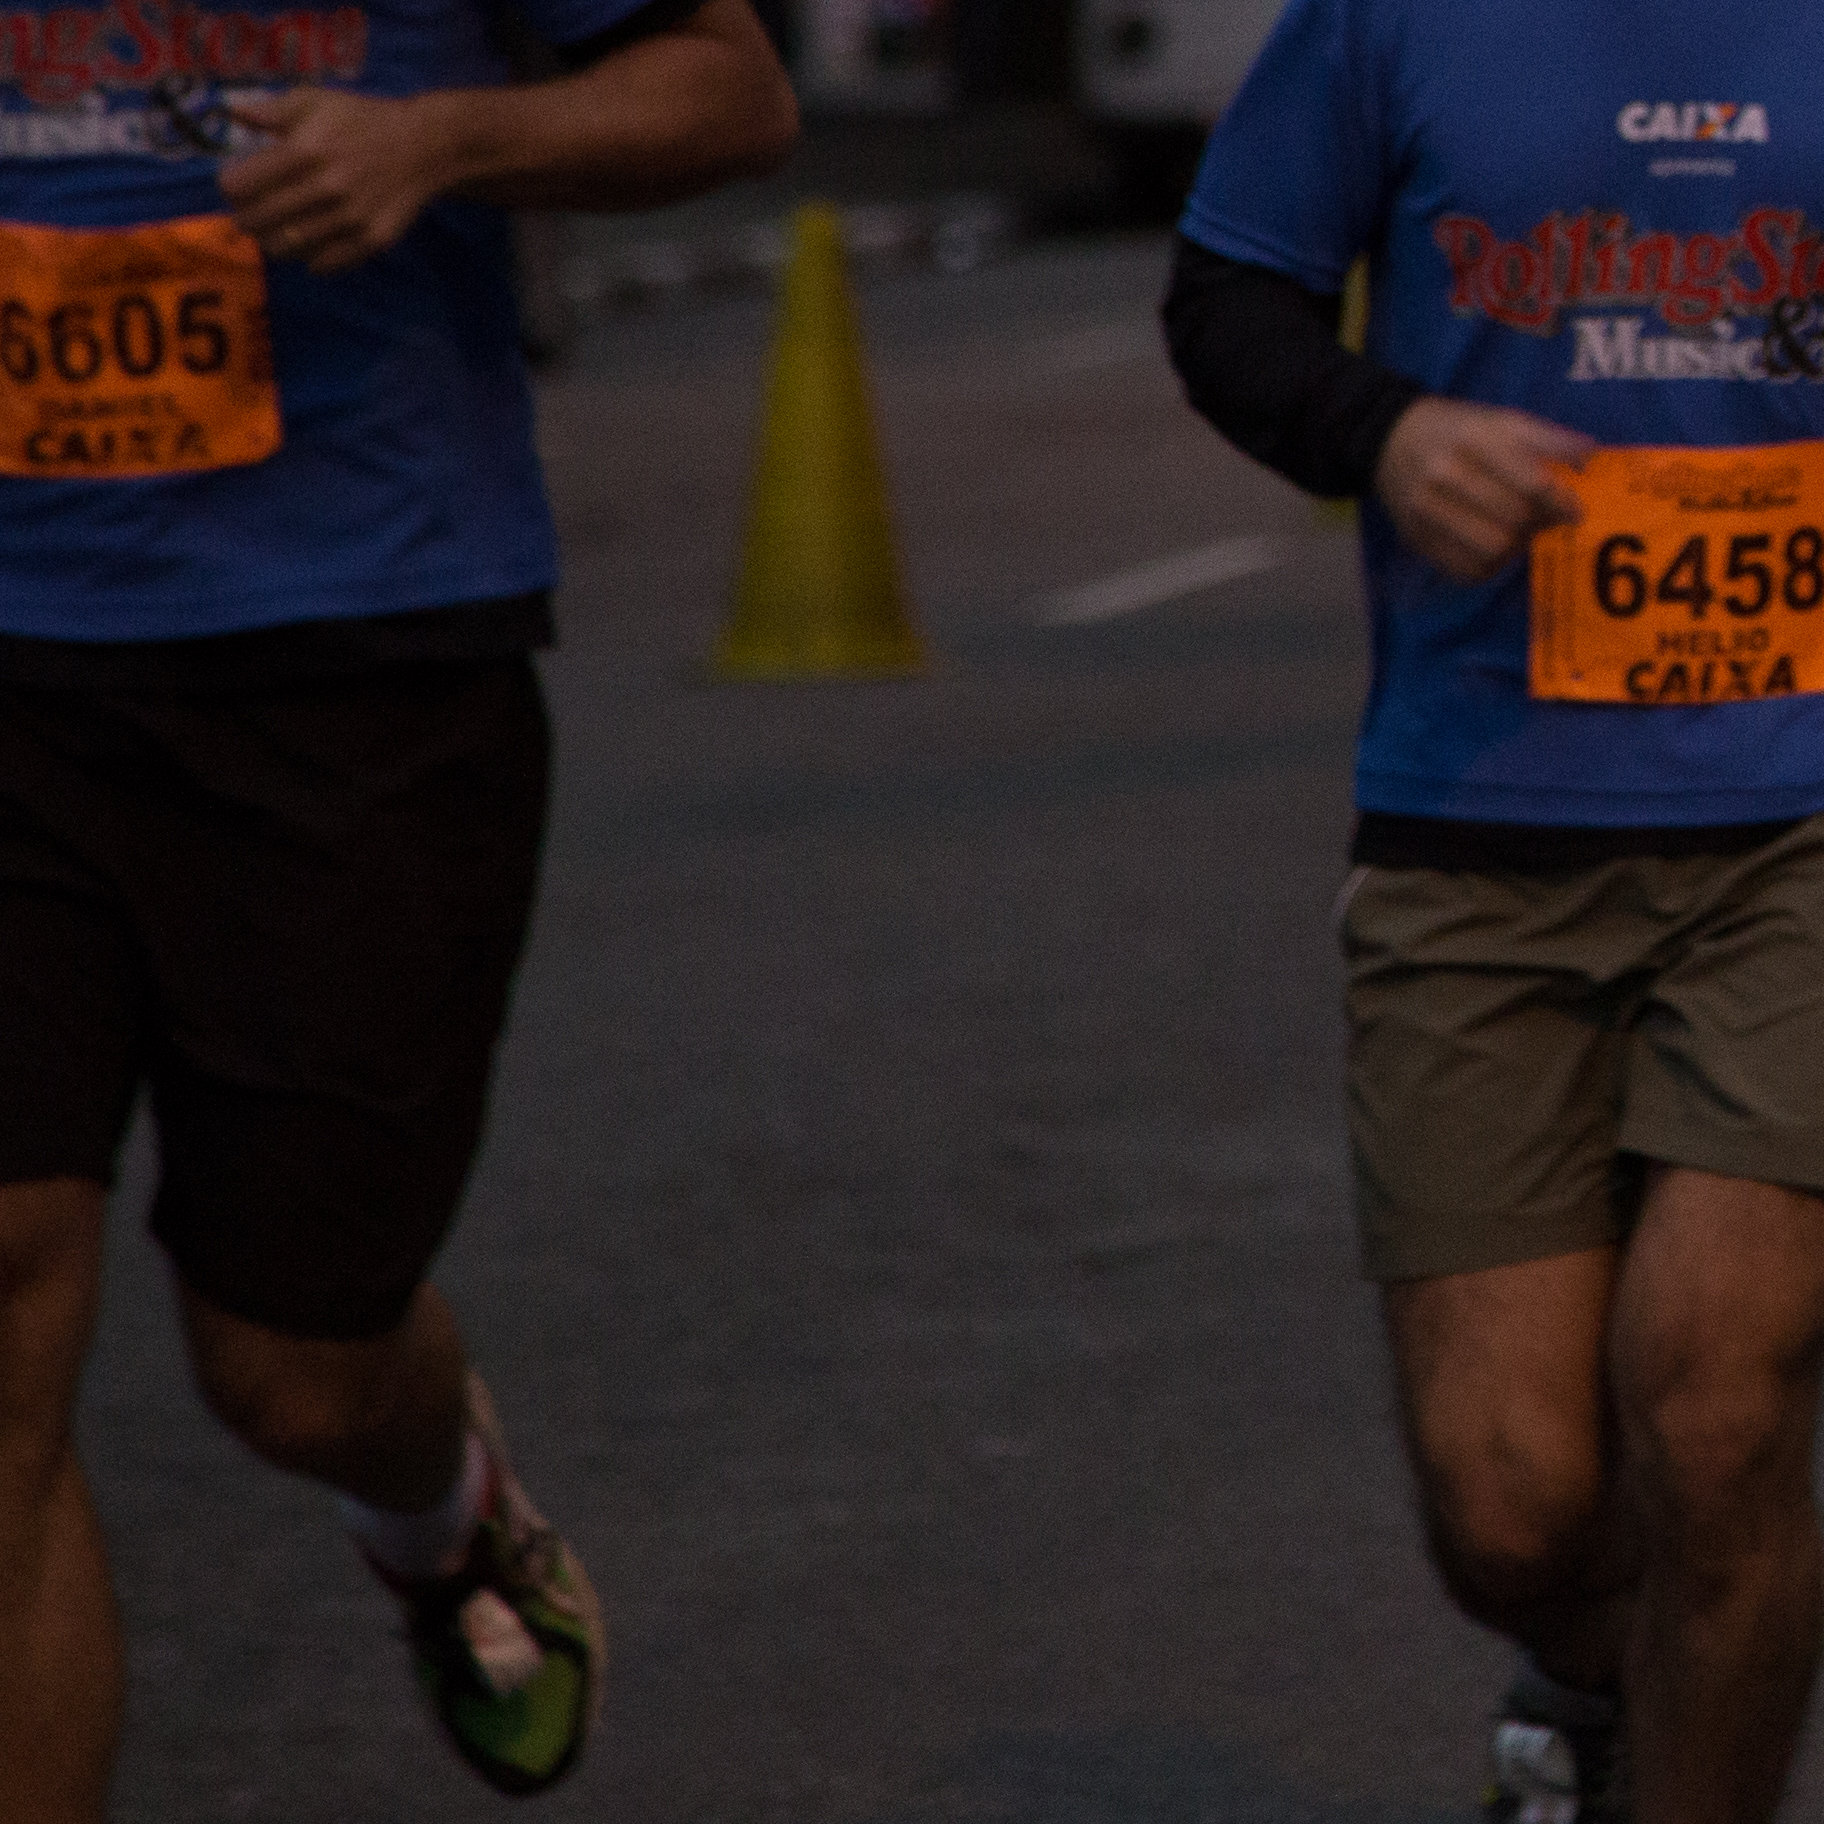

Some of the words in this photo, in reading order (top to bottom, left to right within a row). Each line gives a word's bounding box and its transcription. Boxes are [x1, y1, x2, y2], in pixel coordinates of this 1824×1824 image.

[1616, 100, 1770, 144] CAIXA
[0, 292, 229, 382] 6605
[24, 423, 208, 465] CAIXA
[1625, 655, 1796, 702] CAIXA
